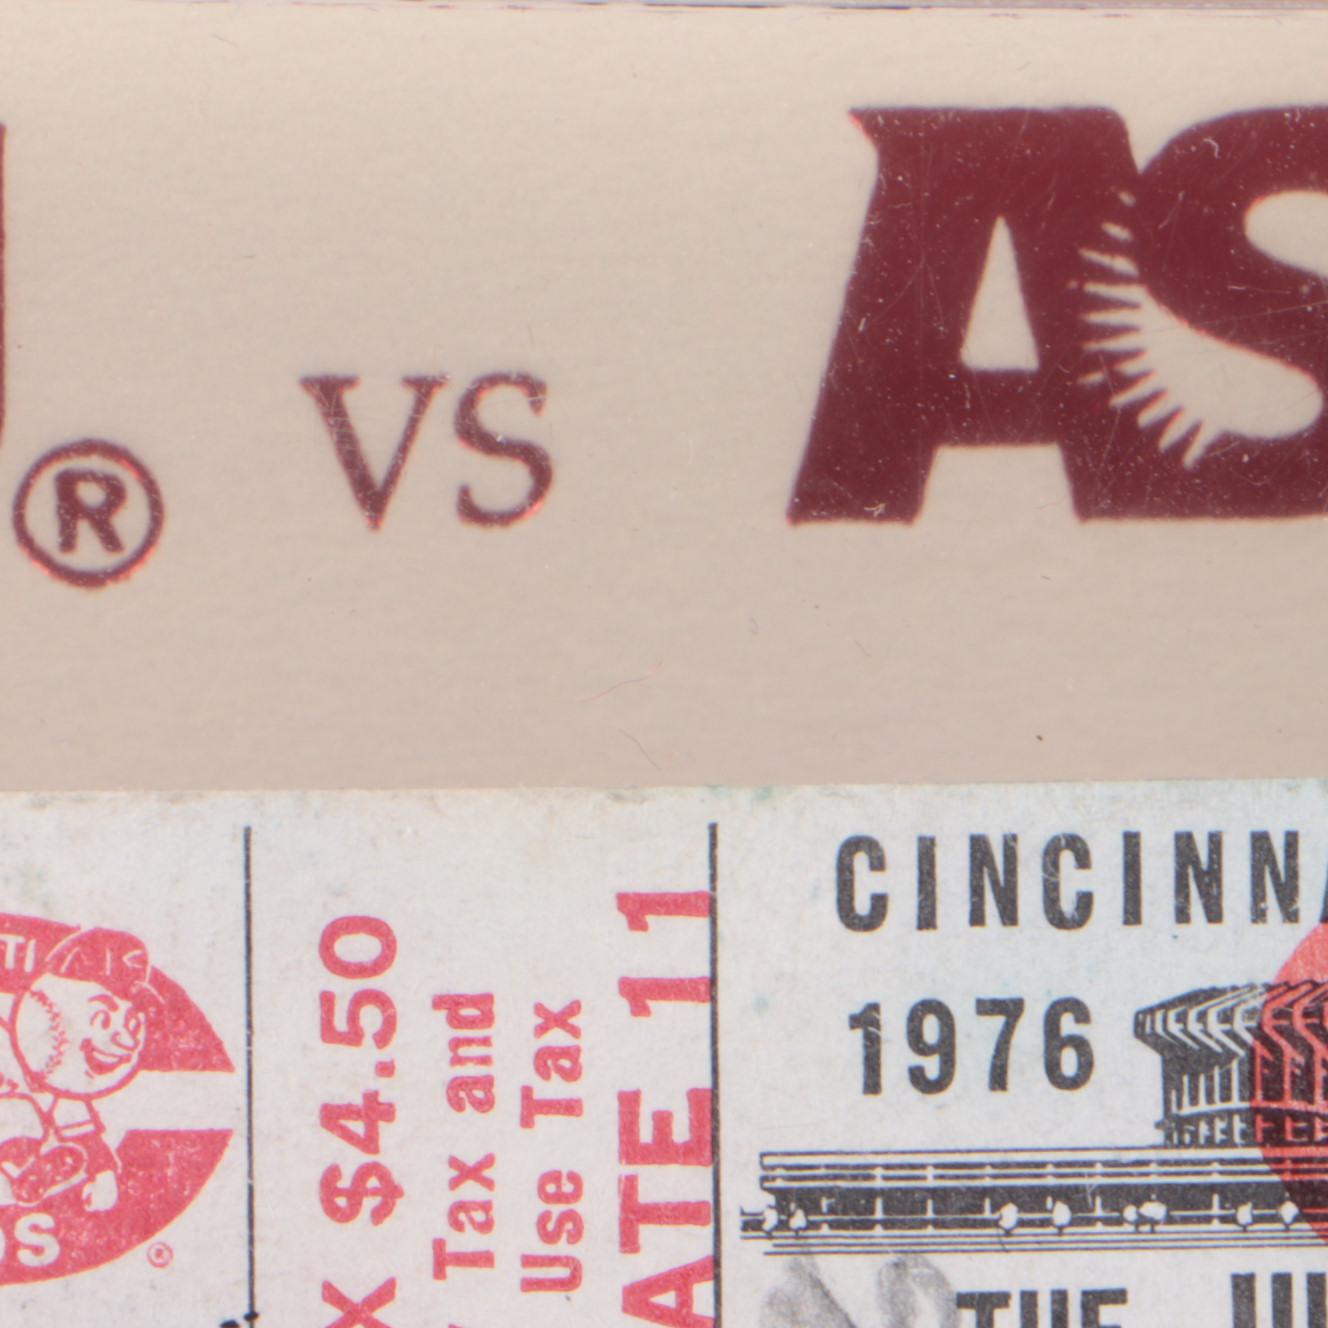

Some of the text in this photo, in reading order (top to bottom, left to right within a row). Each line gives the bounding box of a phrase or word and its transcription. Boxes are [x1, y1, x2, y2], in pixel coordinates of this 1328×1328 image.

[616, 890, 711, 1017] 11
[319, 915, 405, 1226] $4.50
[432, 992, 496, 1114] and
[520, 1000, 584, 1129] Tax
[851, 999, 1093, 1093] 1976
[432, 1153, 496, 1281] Tax
[520, 1170, 585, 1293] Use
